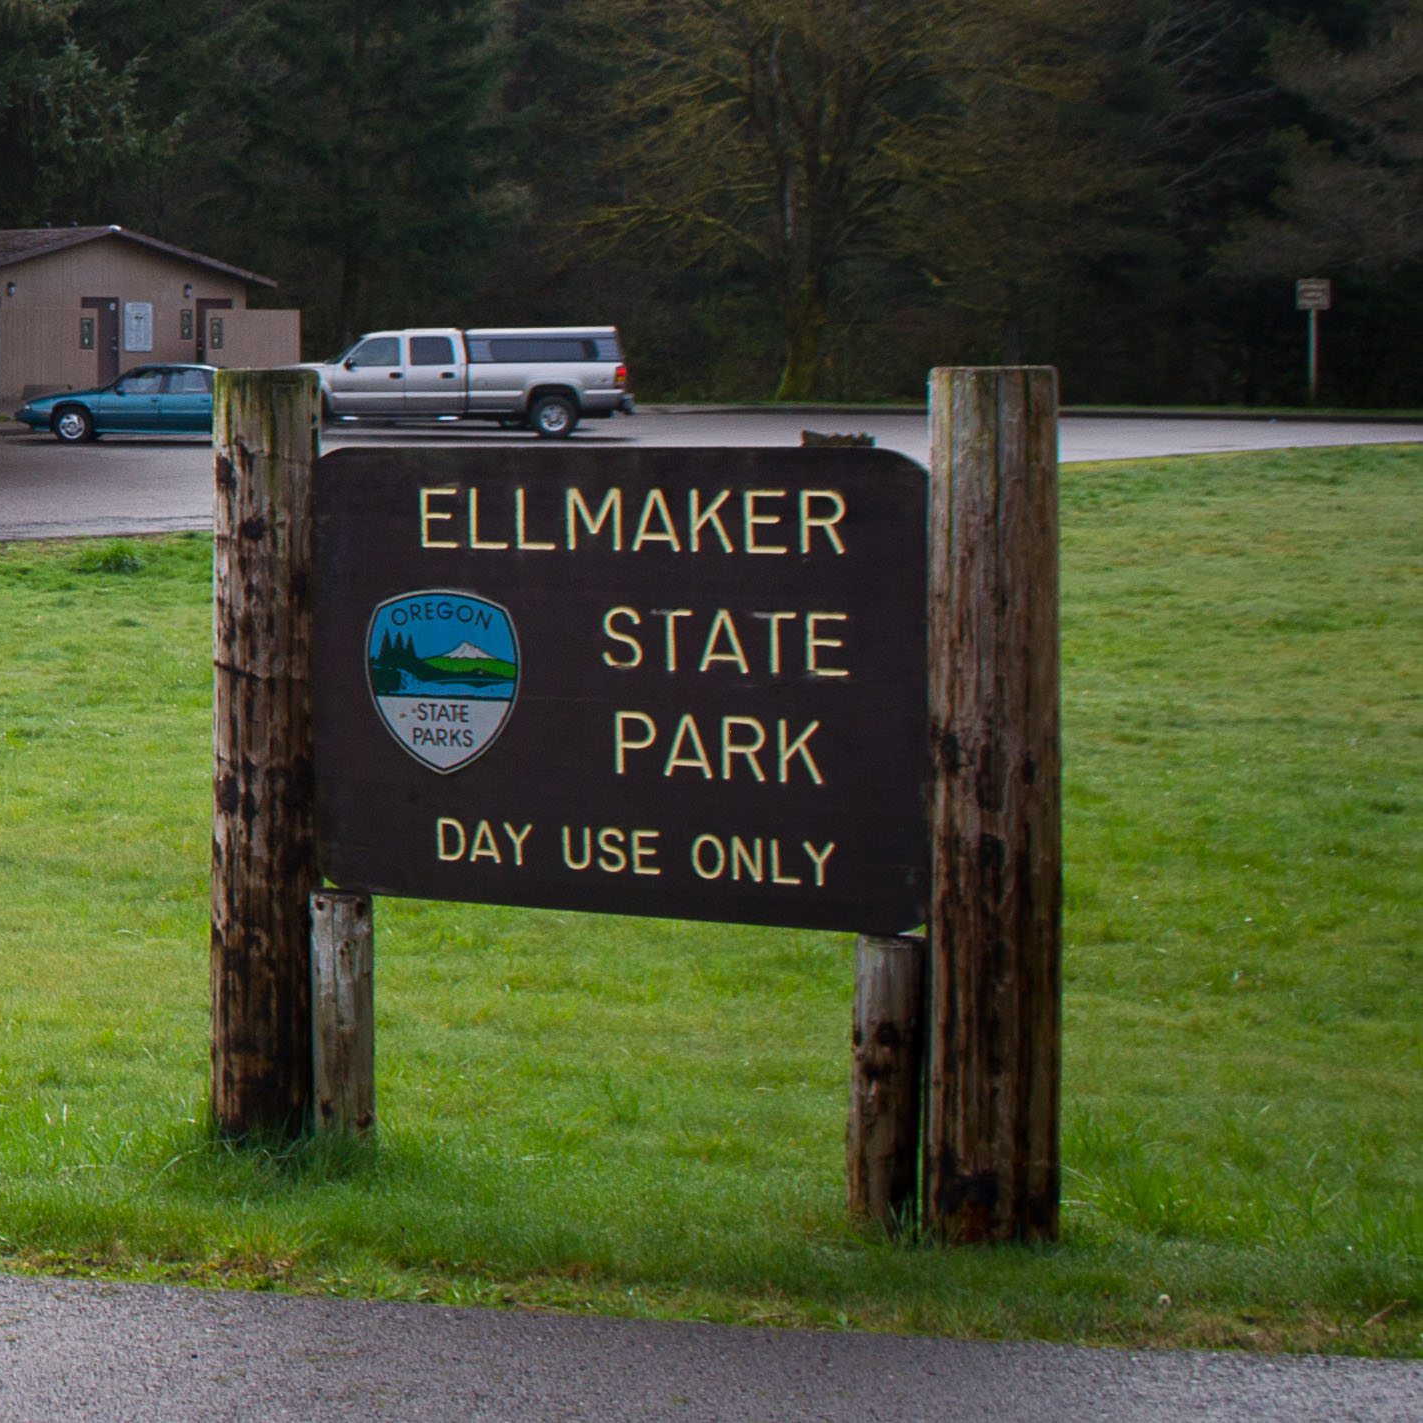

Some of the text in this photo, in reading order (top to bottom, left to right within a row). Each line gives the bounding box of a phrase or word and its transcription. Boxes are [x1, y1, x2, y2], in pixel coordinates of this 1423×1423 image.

[418, 486, 846, 556] ELLMAKER
[390, 601, 493, 629] OREGON
[601, 605, 850, 678] STATE
[412, 727, 474, 748] PARKS
[416, 702, 470, 723] STATE
[614, 710, 824, 786] PARK
[436, 816, 836, 888] DAY USE ONLY
